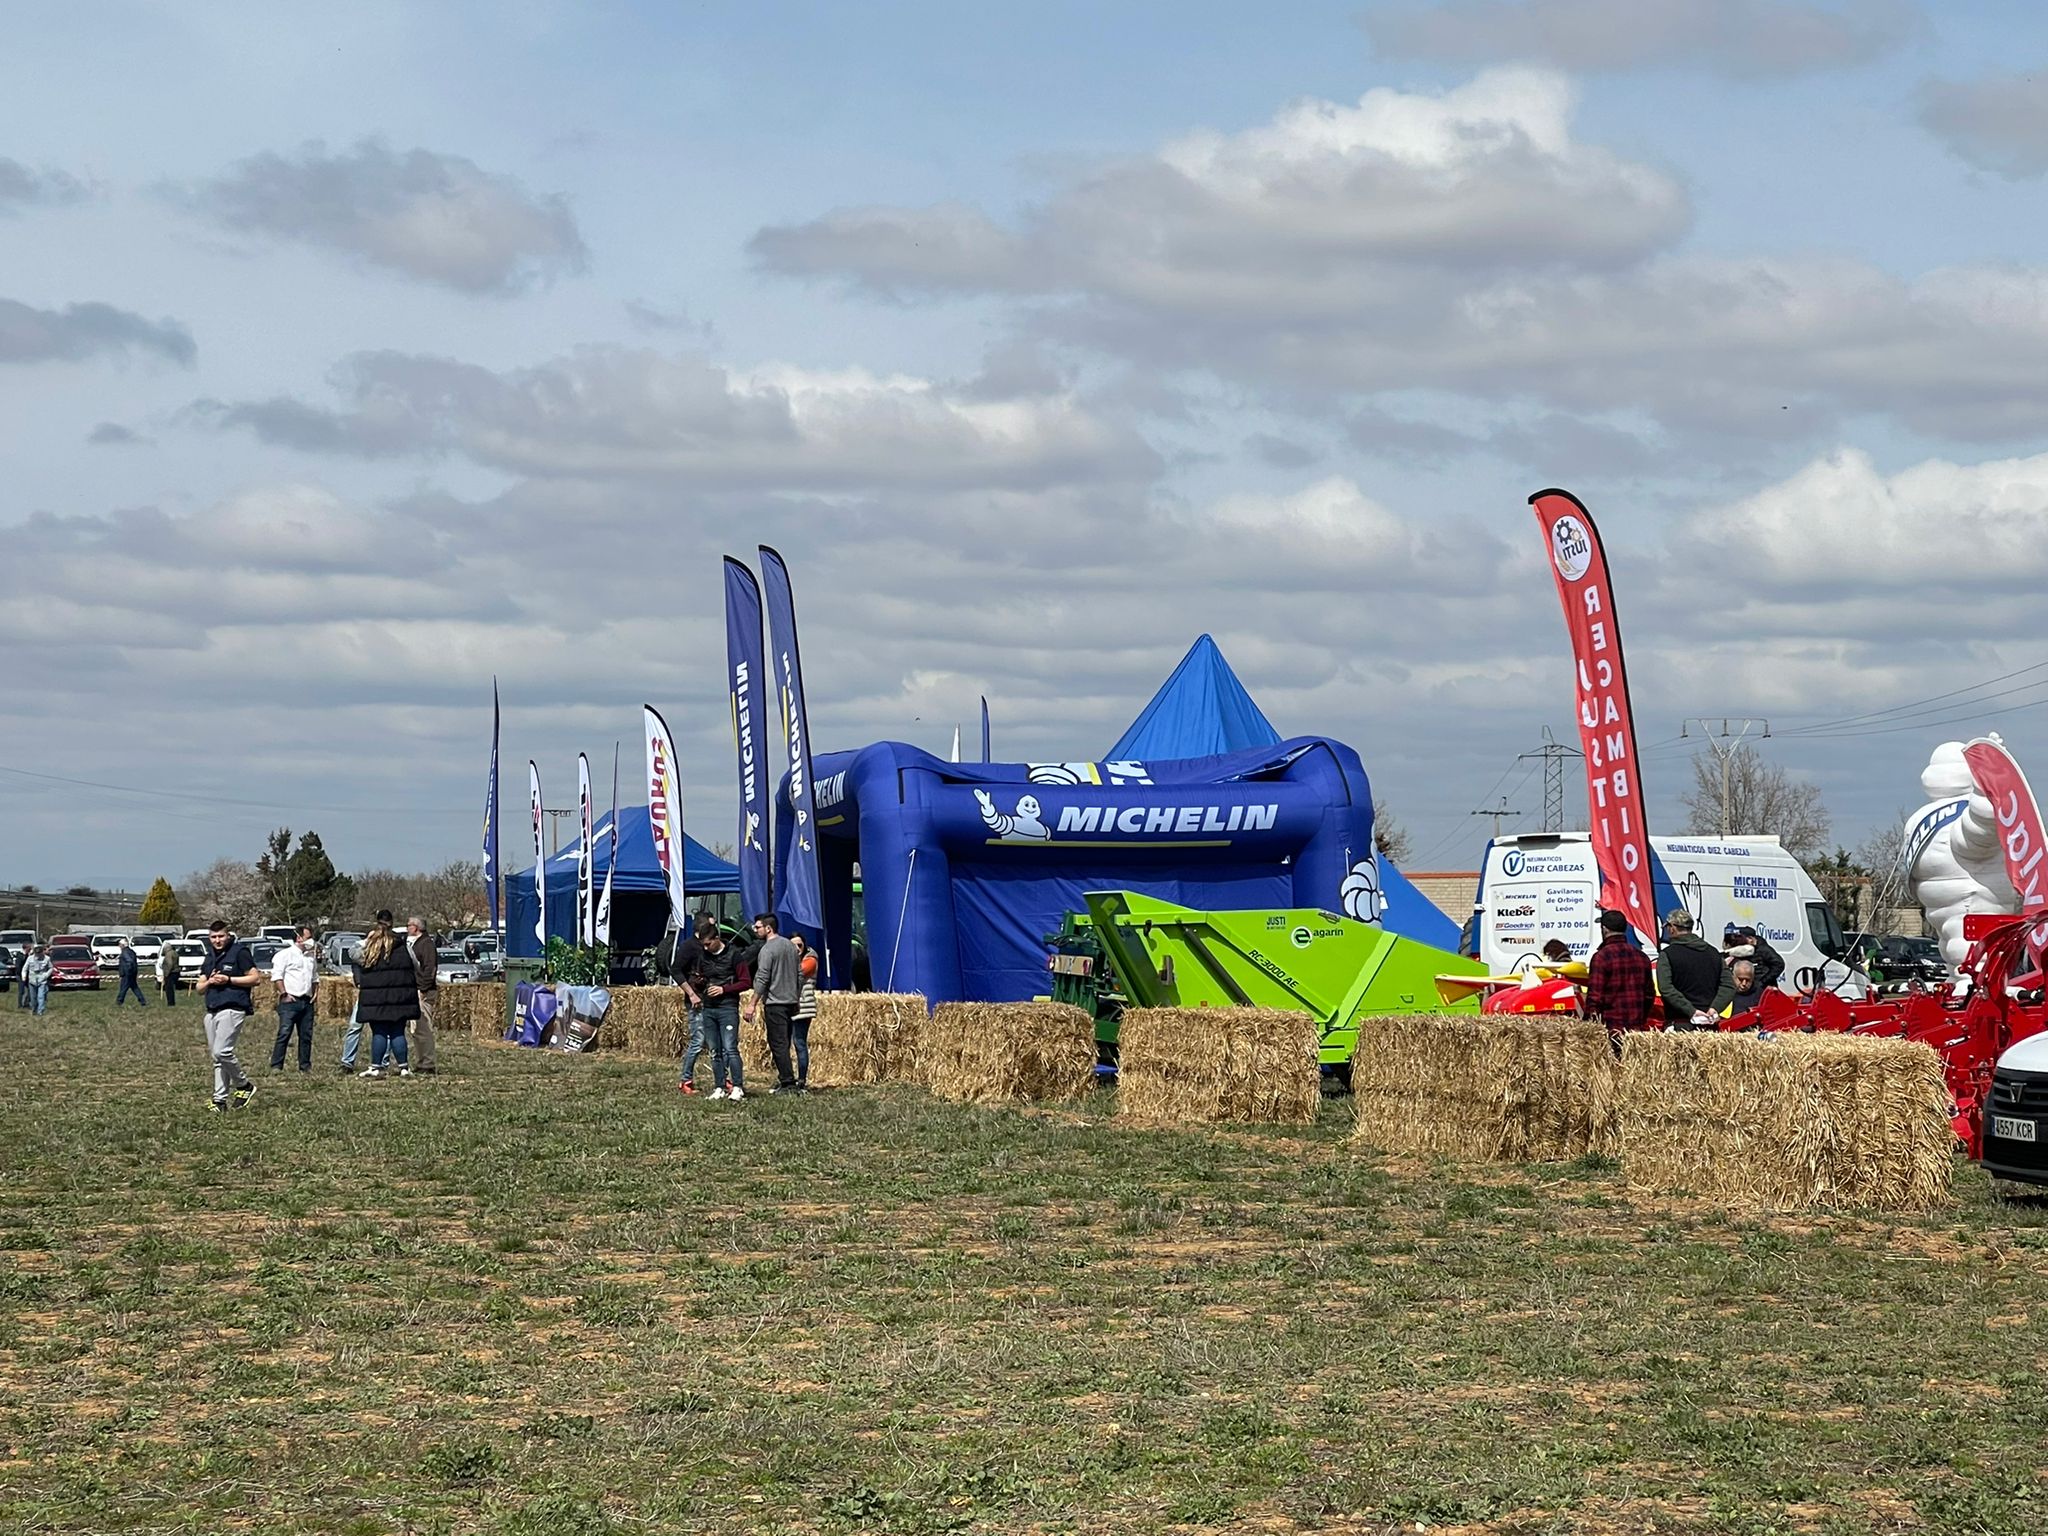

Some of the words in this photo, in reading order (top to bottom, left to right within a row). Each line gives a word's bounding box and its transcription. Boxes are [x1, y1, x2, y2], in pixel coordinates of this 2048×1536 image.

[814, 770, 846, 809] HELIN
[1057, 804, 1279, 832] MICHELIN
[1707, 846, 1721, 855] DIEZ
[1724, 847, 1750, 856] CABEZAS
[1526, 865, 1545, 873] DIEZ
[1547, 864, 1585, 872] CABEZAS
[1734, 876, 1777, 887] MICHELIN
[1734, 889, 1777, 899] EXELAGRI
[1497, 908, 1535, 916] Kleber
[1266, 916, 1286, 925] JUSTI
[1313, 928, 1344, 938] agarin
[1249, 949, 1286, 978] RC-3000
[1283, 976, 1299, 988] AE
[2016, 1122, 2033, 1139] KCR
